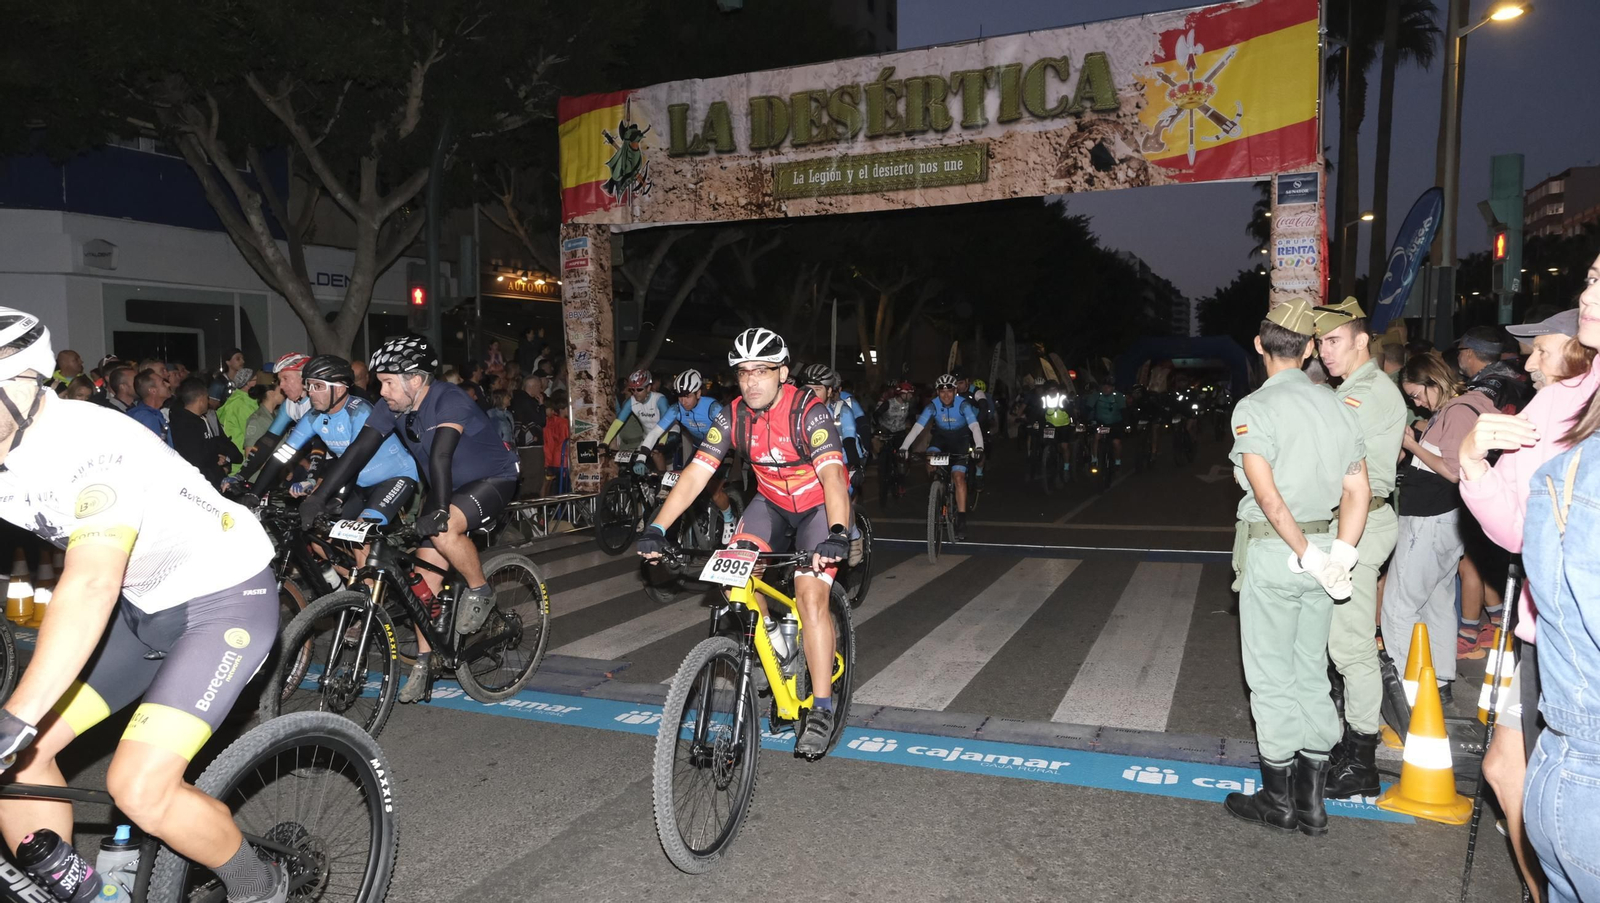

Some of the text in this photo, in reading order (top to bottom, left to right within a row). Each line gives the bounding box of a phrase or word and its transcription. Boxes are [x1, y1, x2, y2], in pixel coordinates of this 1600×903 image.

[667, 51, 1121, 158] LA DESÉRTICA
[792, 160, 964, 186] La Legión y el desierto nos une
[1277, 238, 1315, 246] GRUPO
[1277, 245, 1316, 256] RENTA
[807, 413, 829, 431] MURCIA
[712, 558, 750, 576] 8995
[243, 588, 267, 596] FASTER
[383, 623, 397, 660] MAXXIS
[195, 650, 238, 712] Borecom
[225, 654, 243, 683] networks
[906, 744, 1071, 771] cajamar
[980, 762, 1062, 775] CAJA RURAL
[370, 758, 393, 813] MAXXIS
